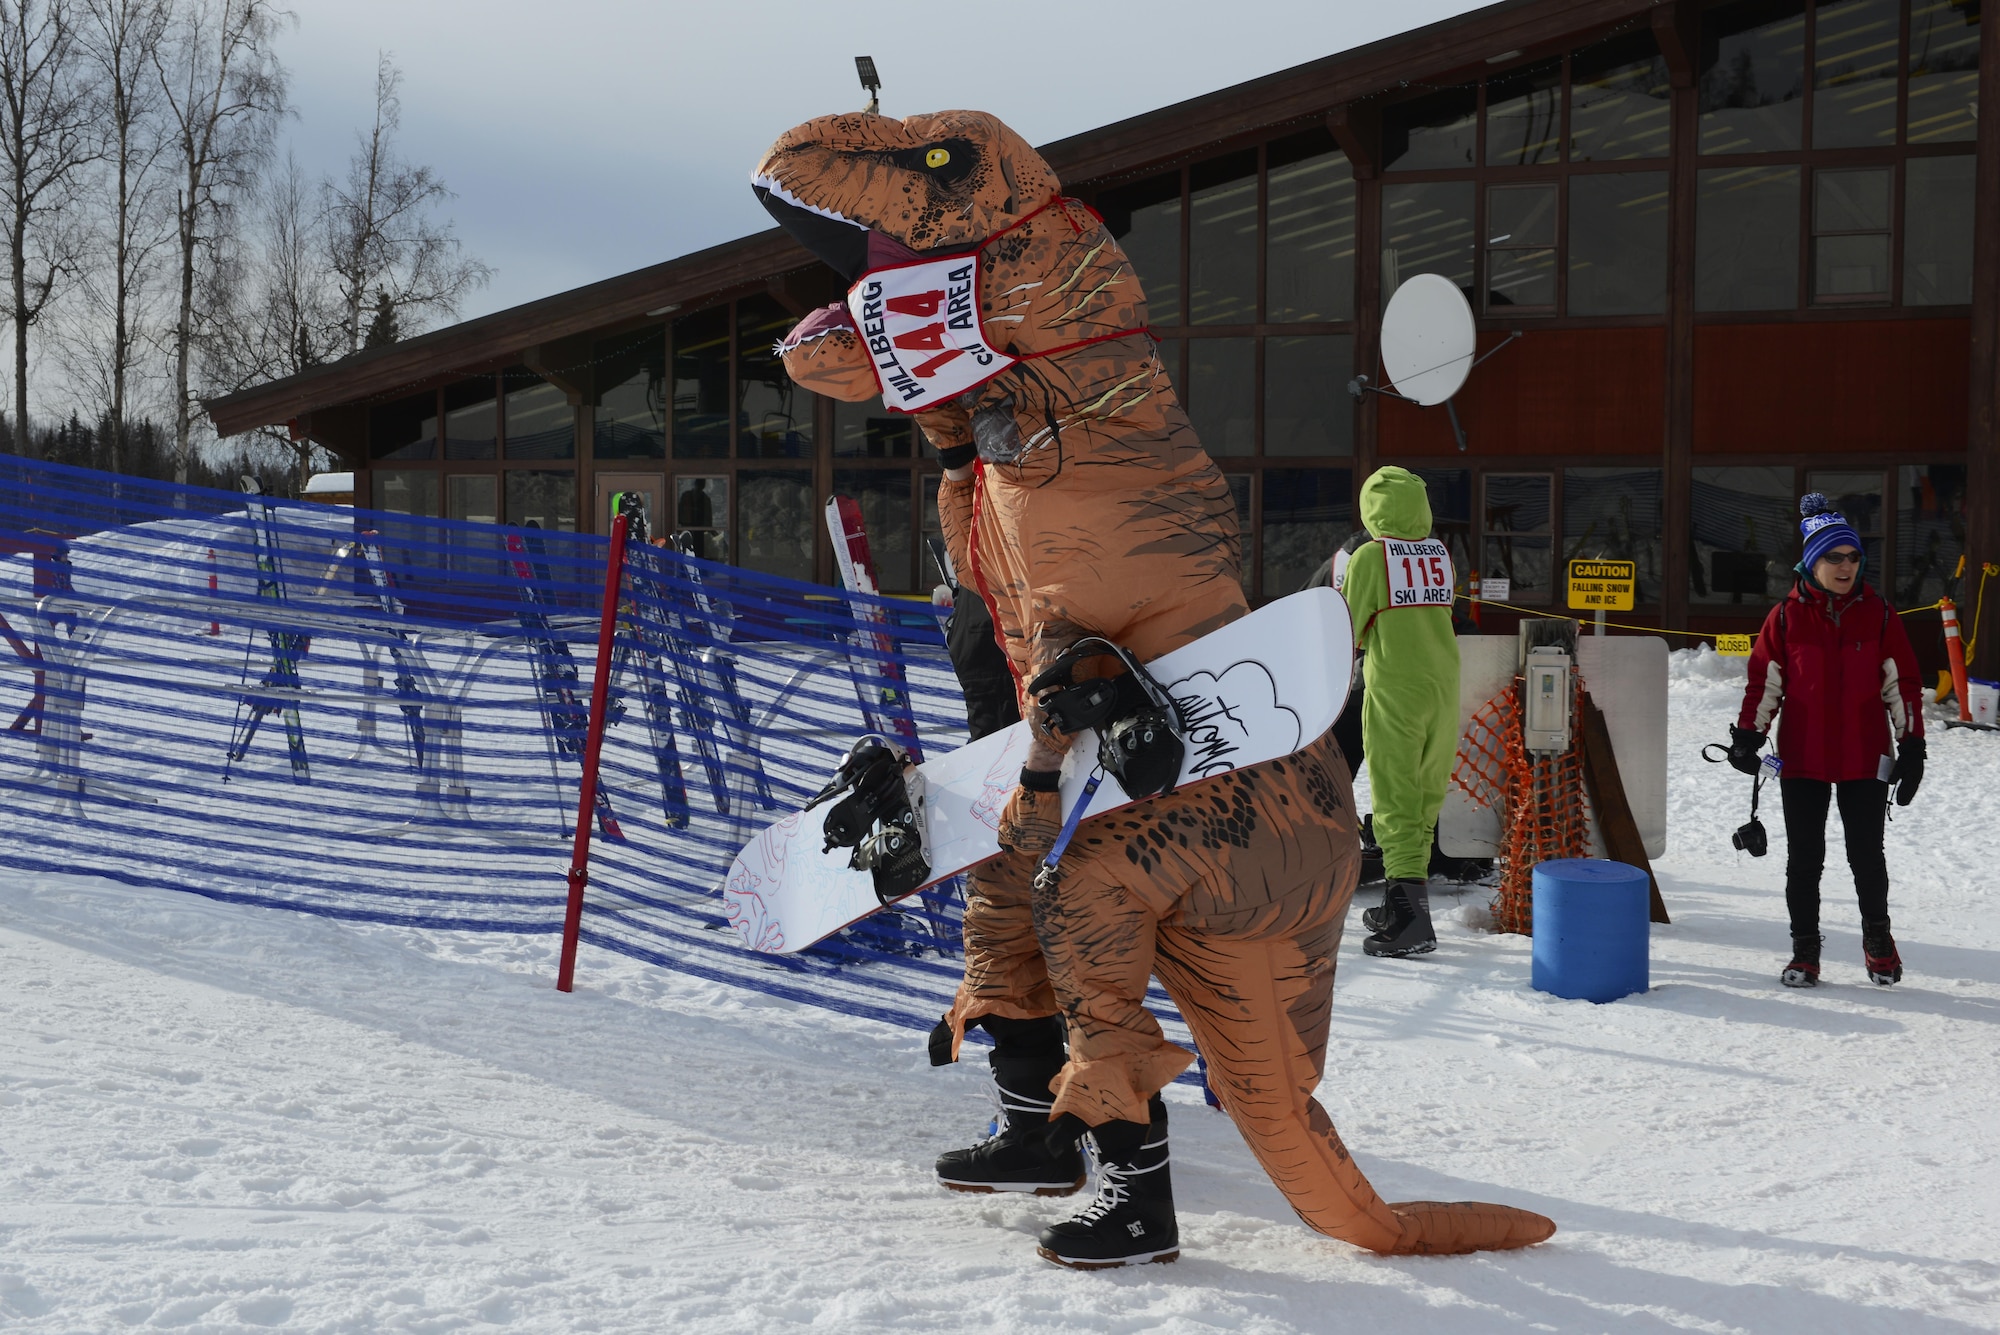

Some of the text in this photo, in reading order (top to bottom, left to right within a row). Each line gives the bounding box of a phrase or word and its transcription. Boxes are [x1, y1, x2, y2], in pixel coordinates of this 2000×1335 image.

[948, 263, 974, 330] AREA
[861, 281, 926, 402] HILLBERG
[886, 290, 965, 378] 144
[1389, 543, 1446, 556] HILLBERG
[1402, 557, 1445, 588] 115
[1575, 565, 1629, 577] CAUTION
[1395, 588, 1451, 604] SKI AREA
[1572, 583, 1630, 593] FALLING SNOW
[1585, 595, 1617, 605] AND ICE
[1718, 640, 1749, 652] CLOSED
[1126, 1220, 1146, 1238] DC
